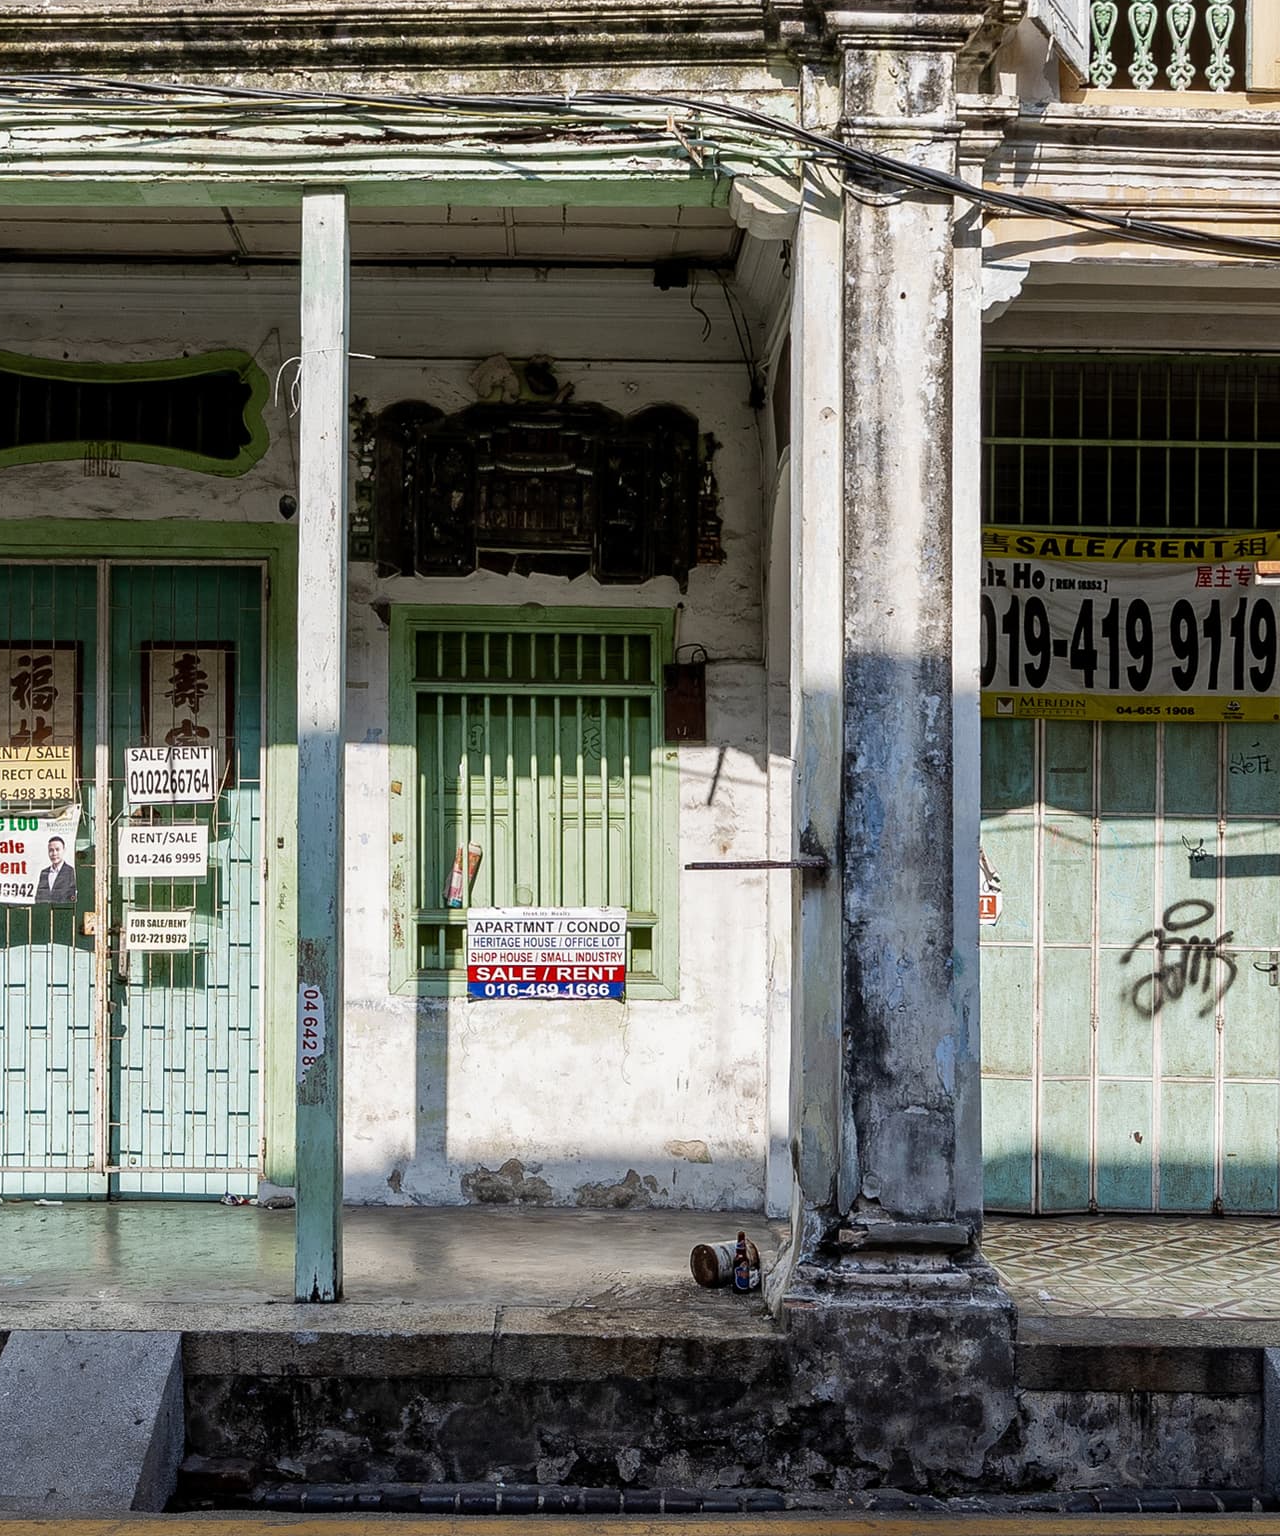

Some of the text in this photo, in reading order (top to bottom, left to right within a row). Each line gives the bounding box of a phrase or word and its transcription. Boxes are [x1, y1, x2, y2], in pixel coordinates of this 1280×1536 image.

[1233, 537, 1269, 557] 租
[981, 561, 1006, 586] iz
[1013, 563, 1045, 589] Ho
[981, 595, 1277, 693] 019-419 9119
[1020, 695, 1087, 708] MERIDIN
[36, 747, 70, 759] SALE
[131, 747, 210, 762] SALE/RENT
[37, 768, 68, 780] CALL
[130, 768, 210, 795] 0102266764
[40, 787, 70, 799] 3158
[130, 831, 198, 844] RENT/SALE
[127, 852, 202, 865] 014-246 9995
[130, 918, 187, 929] FOR SALE/RENT
[474, 921, 554, 934] APARTMNT
[566, 920, 621, 933] CONDO
[130, 933, 188, 944] 012-721 9973
[473, 937, 521, 948] HERITAGE
[523, 937, 557, 948] HOUSE
[564, 936, 599, 947] OFFICE
[601, 936, 621, 947] LOT
[470, 952, 498, 963] SHOP
[500, 952, 534, 963] HOUSE
[540, 951, 573, 963] SMALL
[575, 951, 623, 962] INDUSTRY
[475, 966, 618, 982] SALE / RENT
[484, 983, 610, 996] 016-469 1666
[303, 989, 320, 1012] 04
[302, 1016, 318, 1050] 642
